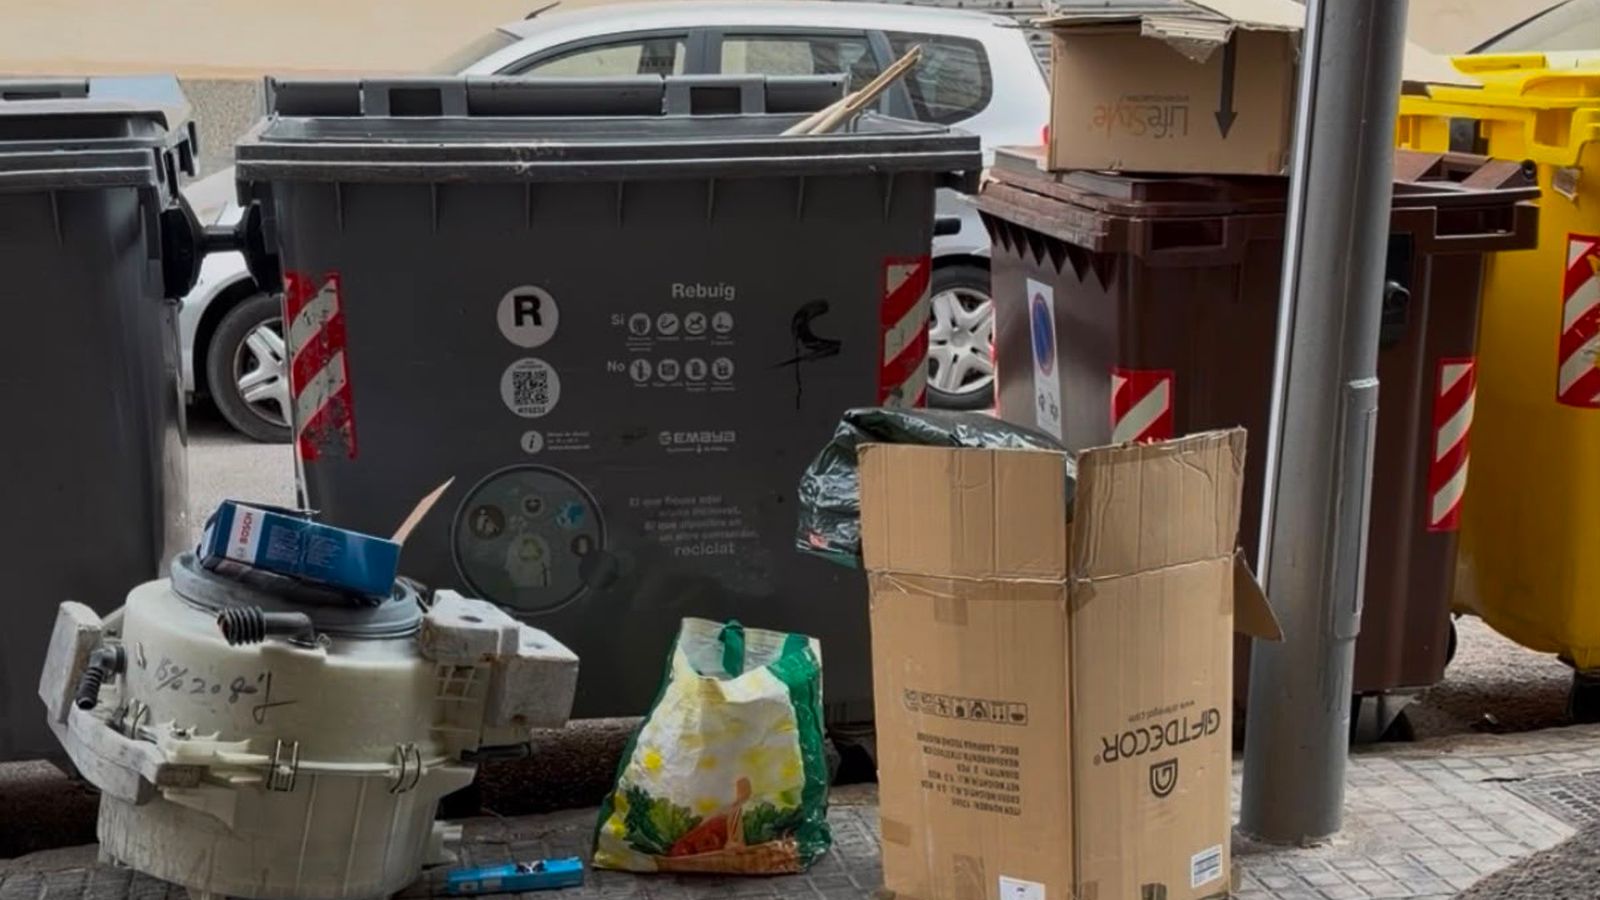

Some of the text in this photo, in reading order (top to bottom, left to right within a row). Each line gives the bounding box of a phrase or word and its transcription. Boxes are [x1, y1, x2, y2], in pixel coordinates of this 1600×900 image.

[1092, 102, 1189, 139] LifeStyle
[671, 282, 736, 301] Rebuig
[513, 295, 542, 327] R
[606, 360, 626, 373] No
[239, 512, 253, 544] BOSCH
[674, 541, 736, 558] reciclat
